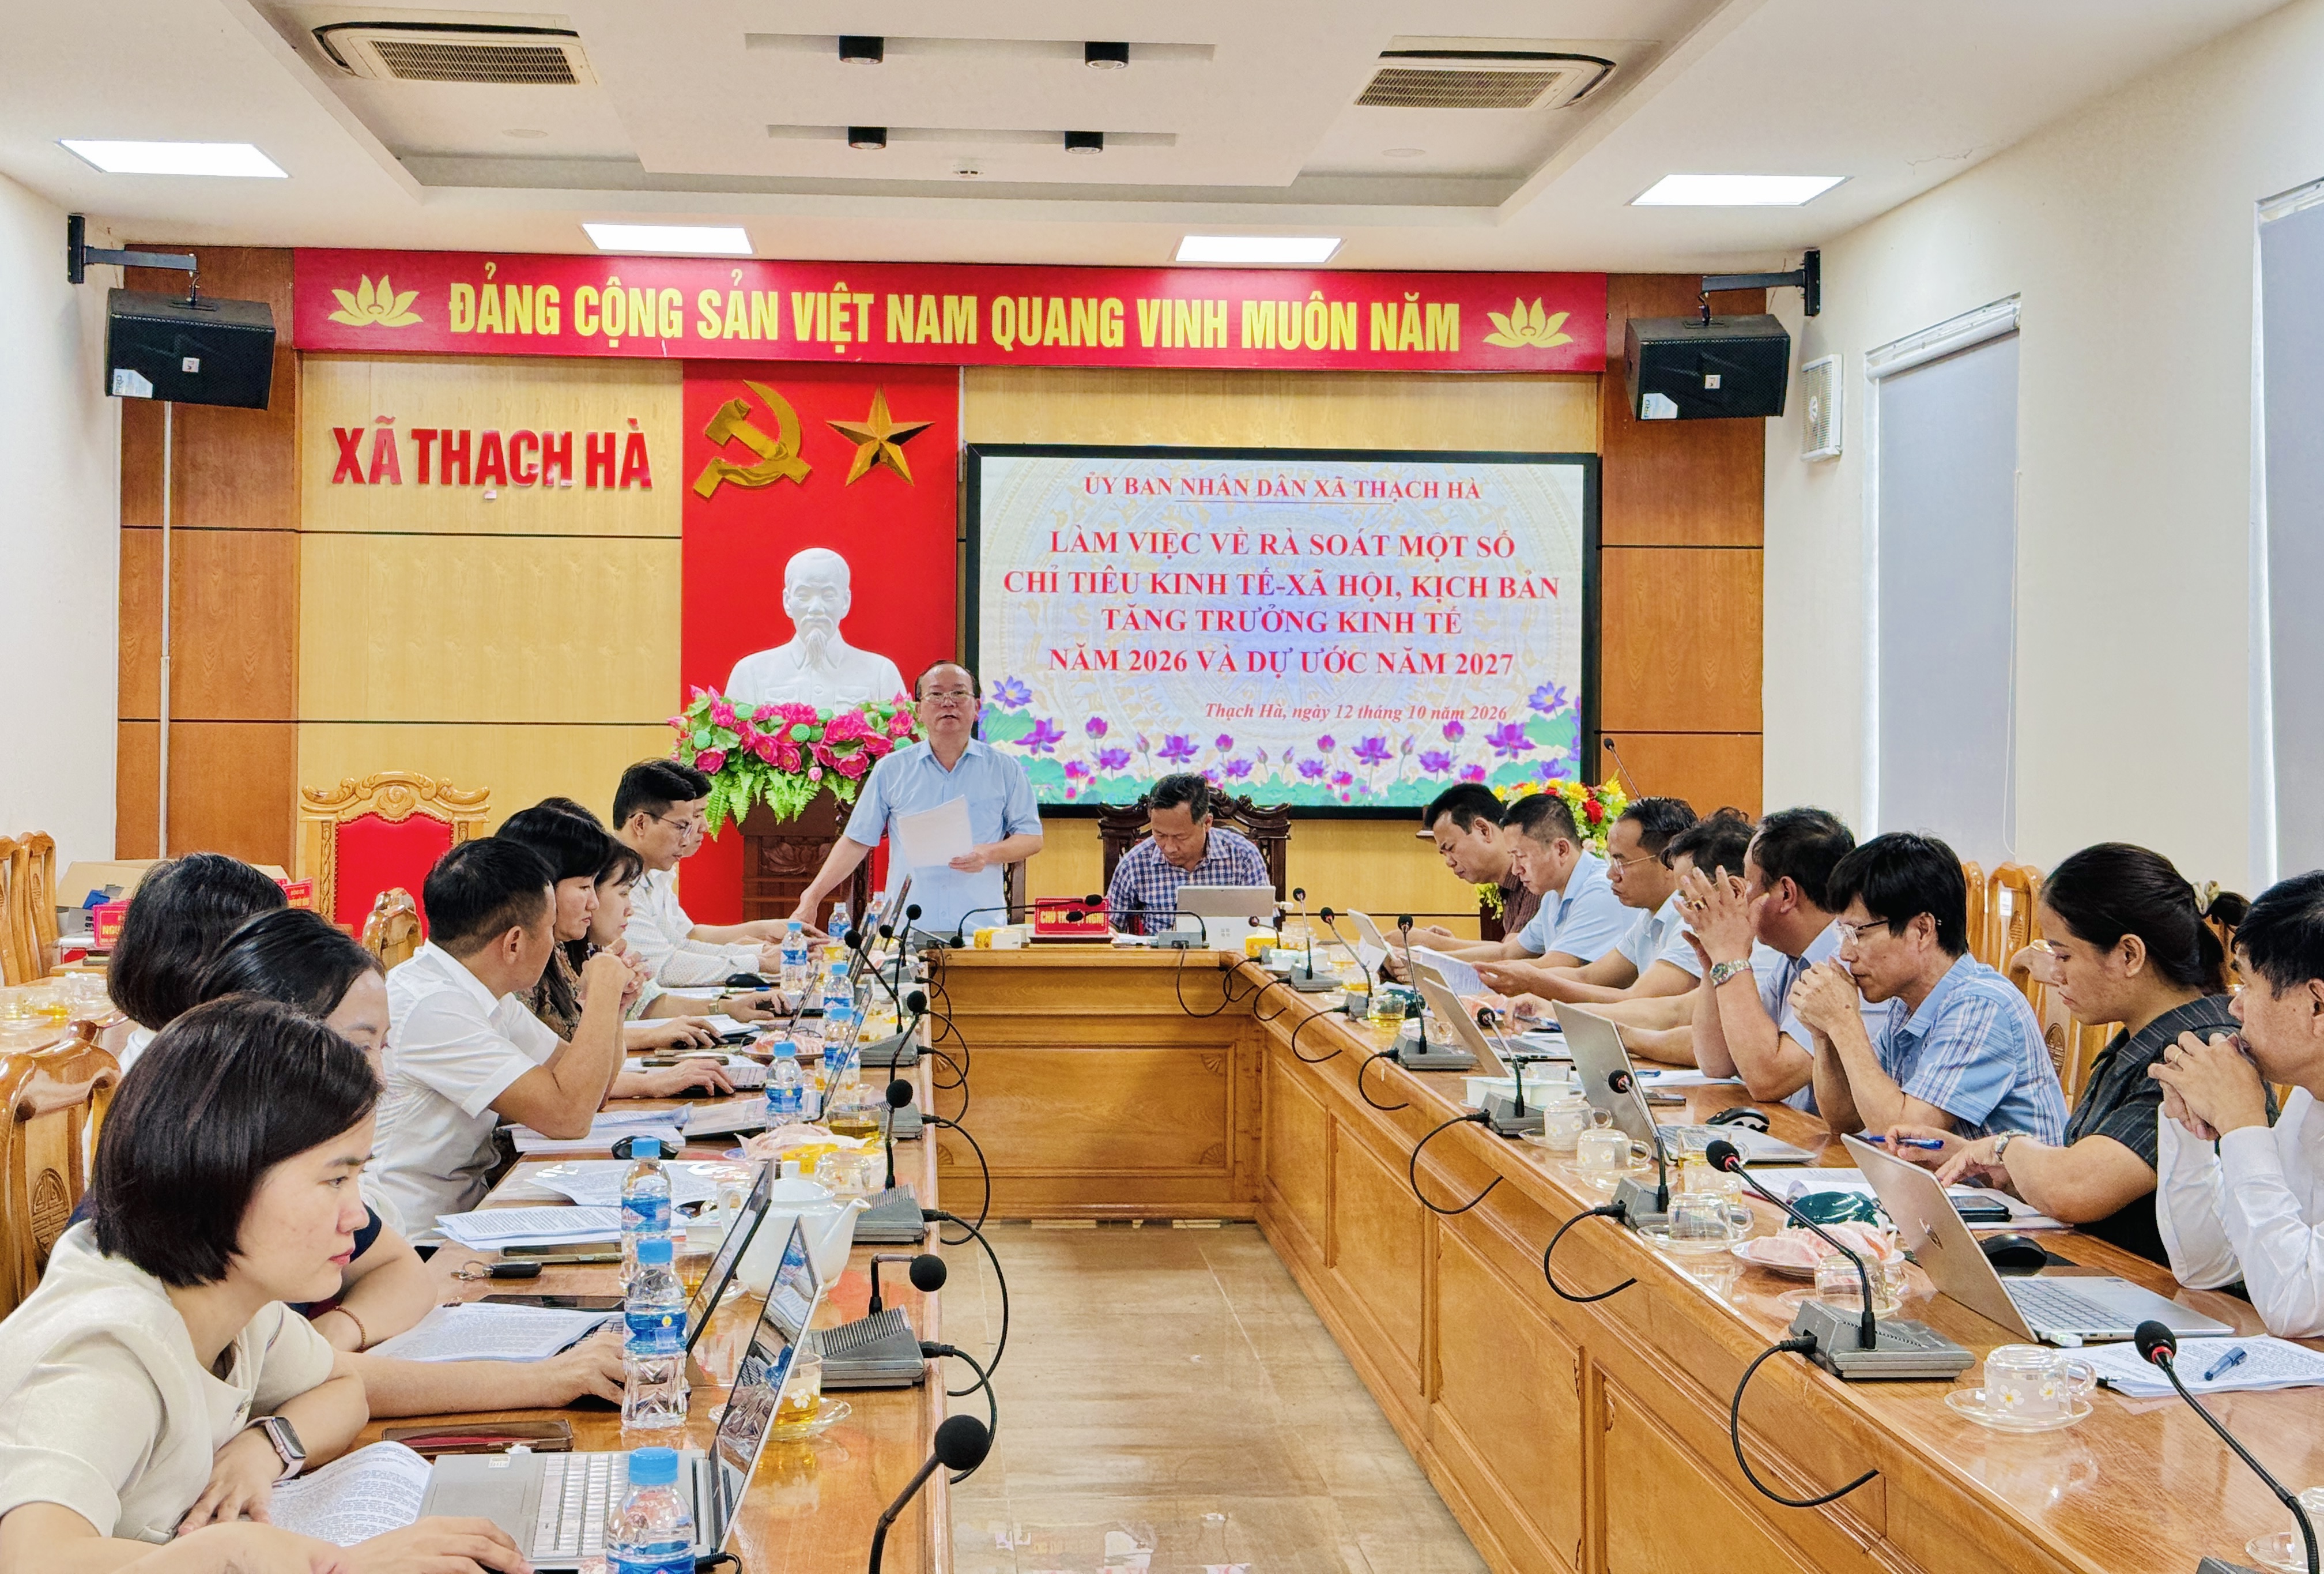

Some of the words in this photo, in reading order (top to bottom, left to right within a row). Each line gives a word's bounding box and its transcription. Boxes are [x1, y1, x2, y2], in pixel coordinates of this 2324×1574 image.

[449, 262, 560, 335] ĐẢNG
[574, 276, 683, 348] CỘNG
[697, 268, 778, 340] SẢN
[791, 282, 874, 353] VIỆT
[886, 294, 978, 344] NAM
[991, 296, 1124, 351] QUANG
[1137, 299, 1228, 348] VINH
[1242, 291, 1357, 351] MUÔN
[1370, 293, 1459, 352] NĂM
[331, 415, 402, 485] XÃ
[410, 428, 573, 499] THẠCH
[584, 417, 653, 489] HÀ
[1085, 472, 1118, 495] ỦY
[1125, 477, 1172, 495] BAN
[1181, 473, 1249, 496] NHÂN
[1257, 473, 1306, 498] DÂN
[1314, 476, 1346, 498] XÃ
[1354, 480, 1439, 503] THẠCH
[1447, 477, 1481, 499] HÀ
[1050, 525, 1119, 553] LÀM
[1126, 529, 1201, 559] VIỆC
[1209, 526, 1249, 555] VỀ
[1259, 527, 1299, 556] RÀ
[1310, 528, 1390, 557] SOÁT
[1398, 532, 1469, 563] MỘT
[1477, 530, 1516, 559] SỐ
[1003, 564, 1059, 593] CHỈ
[1068, 564, 1138, 594] TIÊU
[1150, 573, 1228, 596] KINH
[1236, 567, 1327, 597] TẾ-XÃ
[1337, 571, 1402, 603] HỘI,
[1411, 575, 1489, 604] KỊCH
[1498, 570, 1560, 599] BẢN
[1101, 603, 1188, 631] TĂNG
[1195, 603, 1327, 633] TRƯỞNG
[1337, 611, 1416, 634] KINH
[1424, 606, 1462, 634] TẾ
[1048, 642, 1119, 671] NĂM
[1129, 649, 1188, 672] 2026
[1195, 644, 1238, 672] VÀ
[1247, 646, 1293, 679] DỰ
[1301, 646, 1367, 674] ƯỚC
[1376, 646, 1447, 675] NĂM
[1454, 653, 1514, 675] 2027
[1205, 703, 1254, 721] Thạch
[1259, 703, 1286, 720] Hà,
[1292, 703, 1330, 721] ngày
[1335, 704, 1353, 719] 12
[1357, 705, 1403, 723] tháng
[1408, 705, 1427, 720] 10
[1431, 706, 1465, 720] năm
[1470, 705, 1508, 720] 2026
